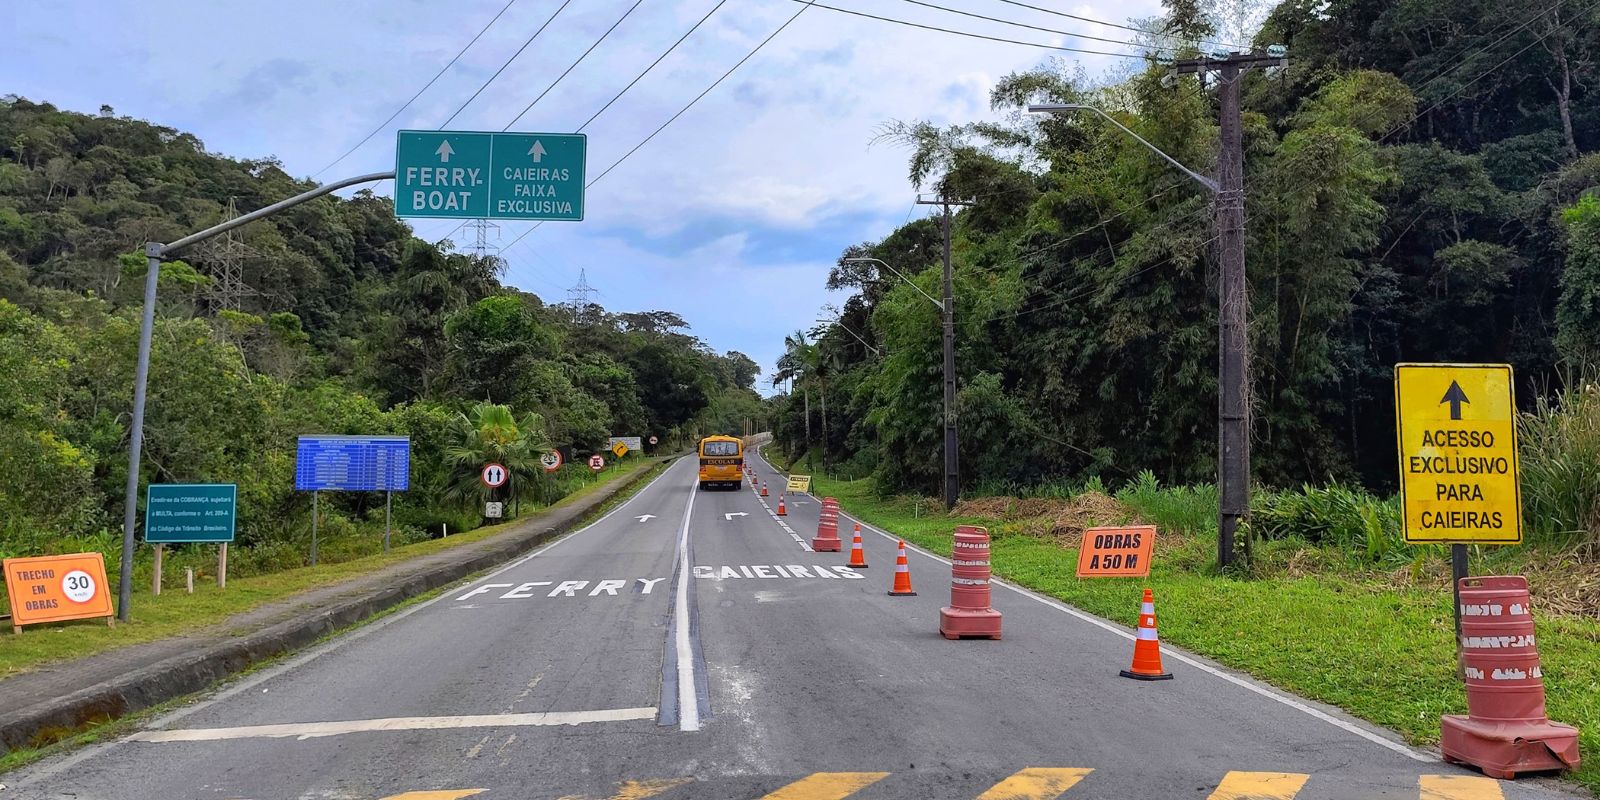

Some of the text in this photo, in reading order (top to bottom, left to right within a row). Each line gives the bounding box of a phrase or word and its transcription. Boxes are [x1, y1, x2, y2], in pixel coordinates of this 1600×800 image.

[405, 167, 483, 187] FERRY-
[503, 167, 570, 182] CAIEIRAS
[514, 184, 557, 198] FAIXA
[413, 190, 472, 211] BOAT
[498, 200, 573, 214] EXCLUSIVA
[1422, 430, 1495, 448] ACESSO
[1409, 456, 1509, 475] EXCLUSIVO
[180, 496, 209, 504] COBRANÇA
[1436, 483, 1484, 501] PARA
[1421, 511, 1503, 529] CAIEIRAS
[1094, 533, 1142, 550] OBRAS
[1089, 554, 1138, 570] A 50 M
[16, 568, 56, 581] TRECHO
[693, 564, 867, 580] CAIEIRAS
[31, 585, 47, 595] EM
[67, 575, 90, 590] 30
[456, 577, 666, 602] FERRY
[25, 598, 59, 611] OBRAS
